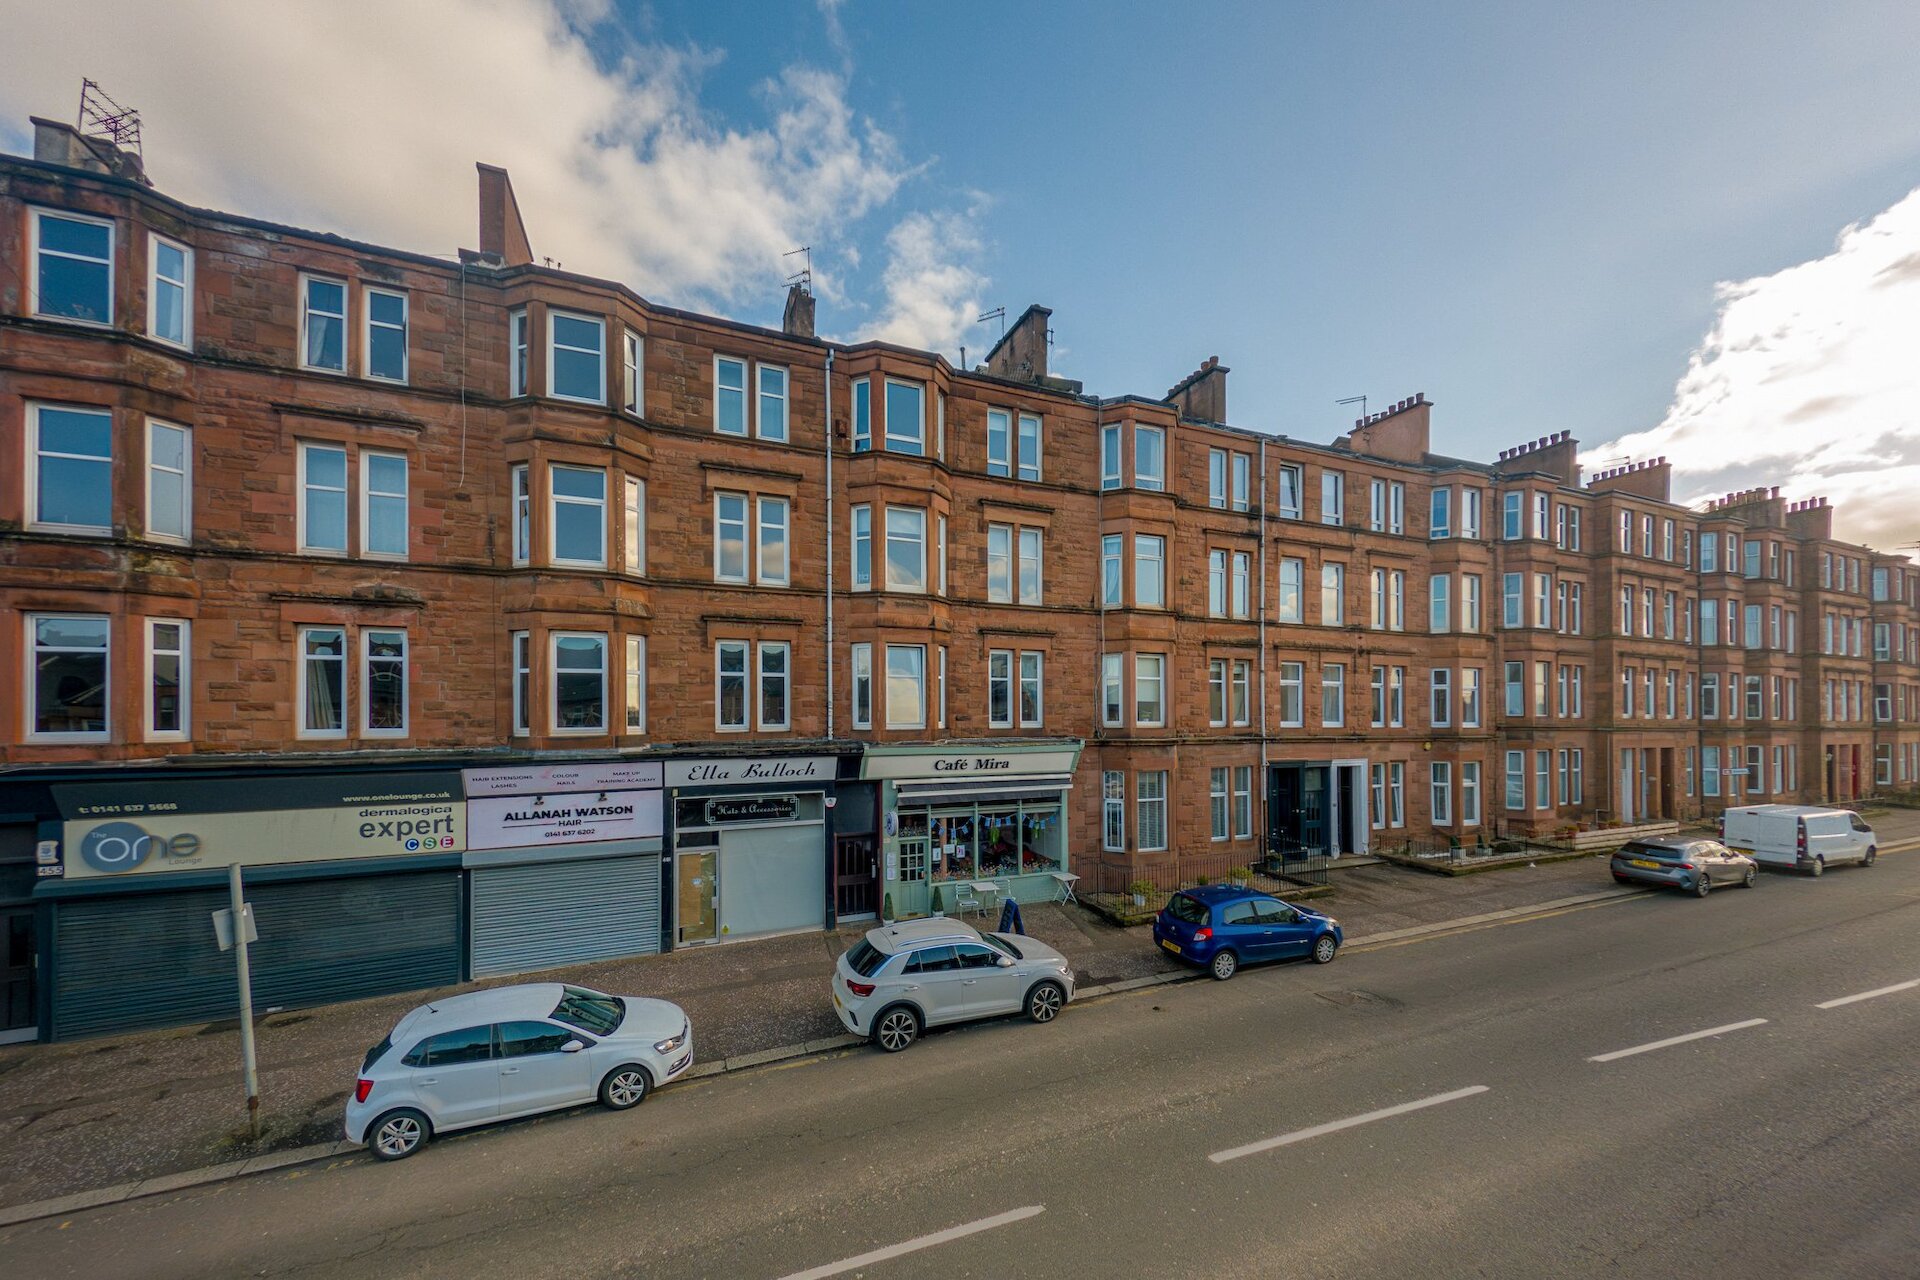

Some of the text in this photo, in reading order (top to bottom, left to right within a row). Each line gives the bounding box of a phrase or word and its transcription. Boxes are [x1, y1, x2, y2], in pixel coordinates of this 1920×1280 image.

[687, 761, 816, 781] Ella Bulloch
[934, 758, 1010, 771] Café Mira
[342, 792, 450, 802] www.onelounge.co.uk
[91, 805, 121, 814] 0141
[359, 805, 452, 818] dermalogica
[503, 805, 633, 822] ALLANAH WATSON
[717, 803, 792, 816] Hats & Accessories
[359, 814, 454, 841] expert
[558, 819, 582, 827] HAIR
[91, 831, 107, 839] The
[577, 828, 596, 836] 6202
[406, 837, 451, 850] C S E
[168, 857, 203, 866] Lounge
